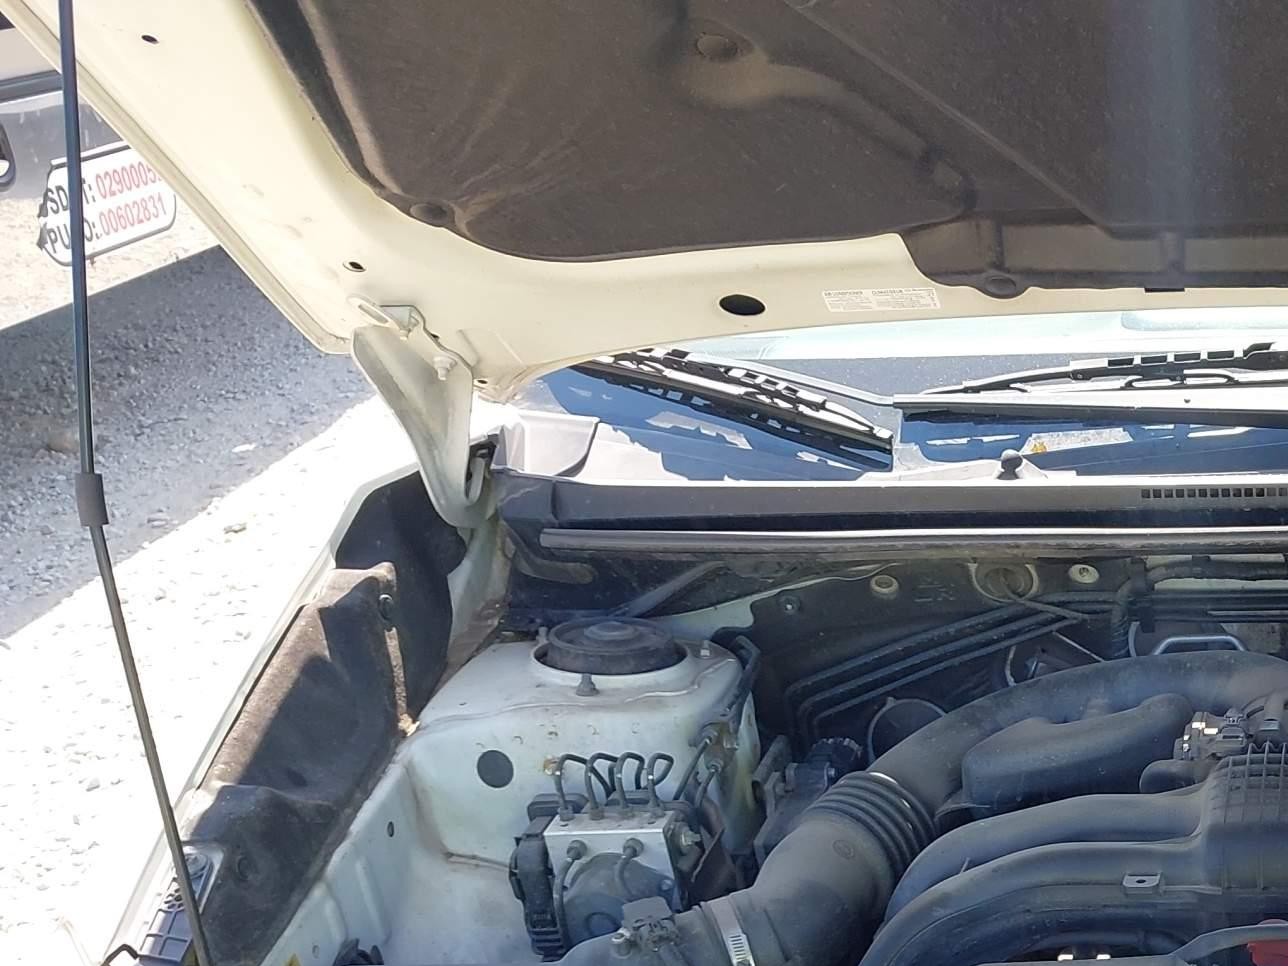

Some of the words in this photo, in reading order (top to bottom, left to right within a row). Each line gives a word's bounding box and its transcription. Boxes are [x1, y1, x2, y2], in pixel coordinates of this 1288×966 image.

[95, 161, 162, 199] 0290005
[47, 218, 100, 253] PUO:
[99, 192, 167, 236] 00602831
